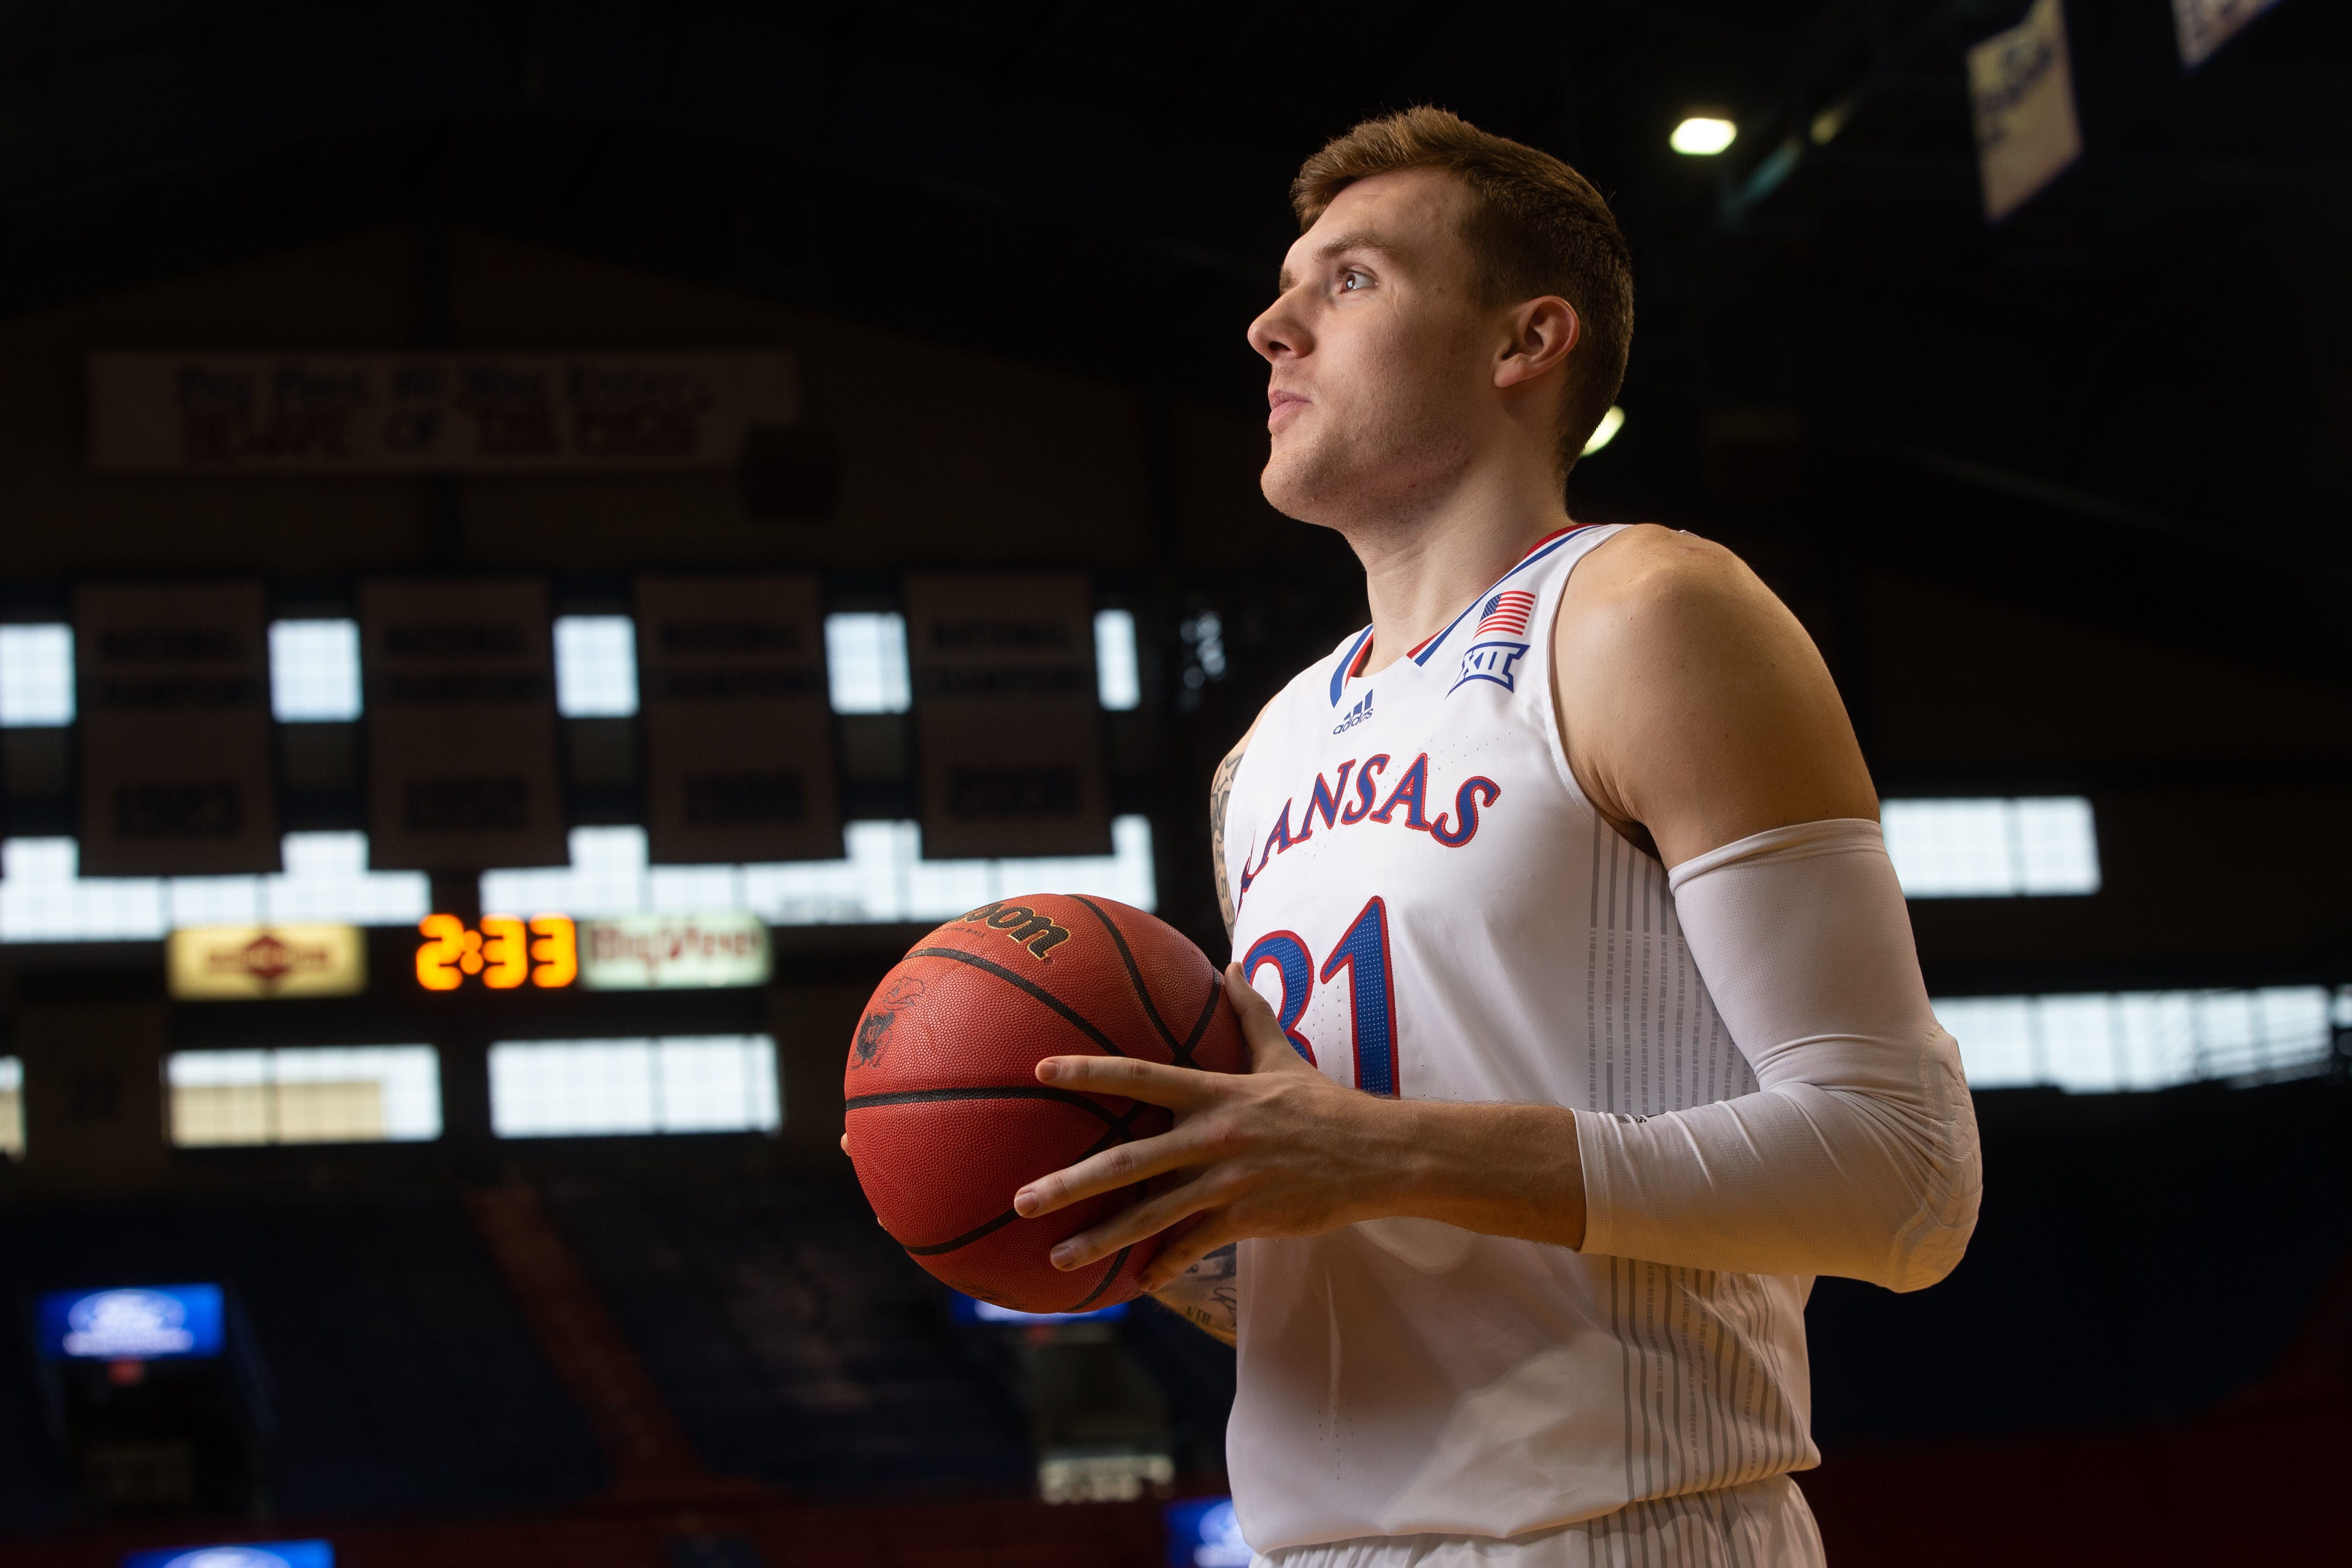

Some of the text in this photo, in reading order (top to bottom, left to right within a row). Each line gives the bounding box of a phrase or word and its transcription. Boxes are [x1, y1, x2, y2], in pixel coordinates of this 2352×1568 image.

[1333, 708, 1373, 734] adidas
[416, 913, 577, 990] 2:33
[948, 903, 1071, 961] son
